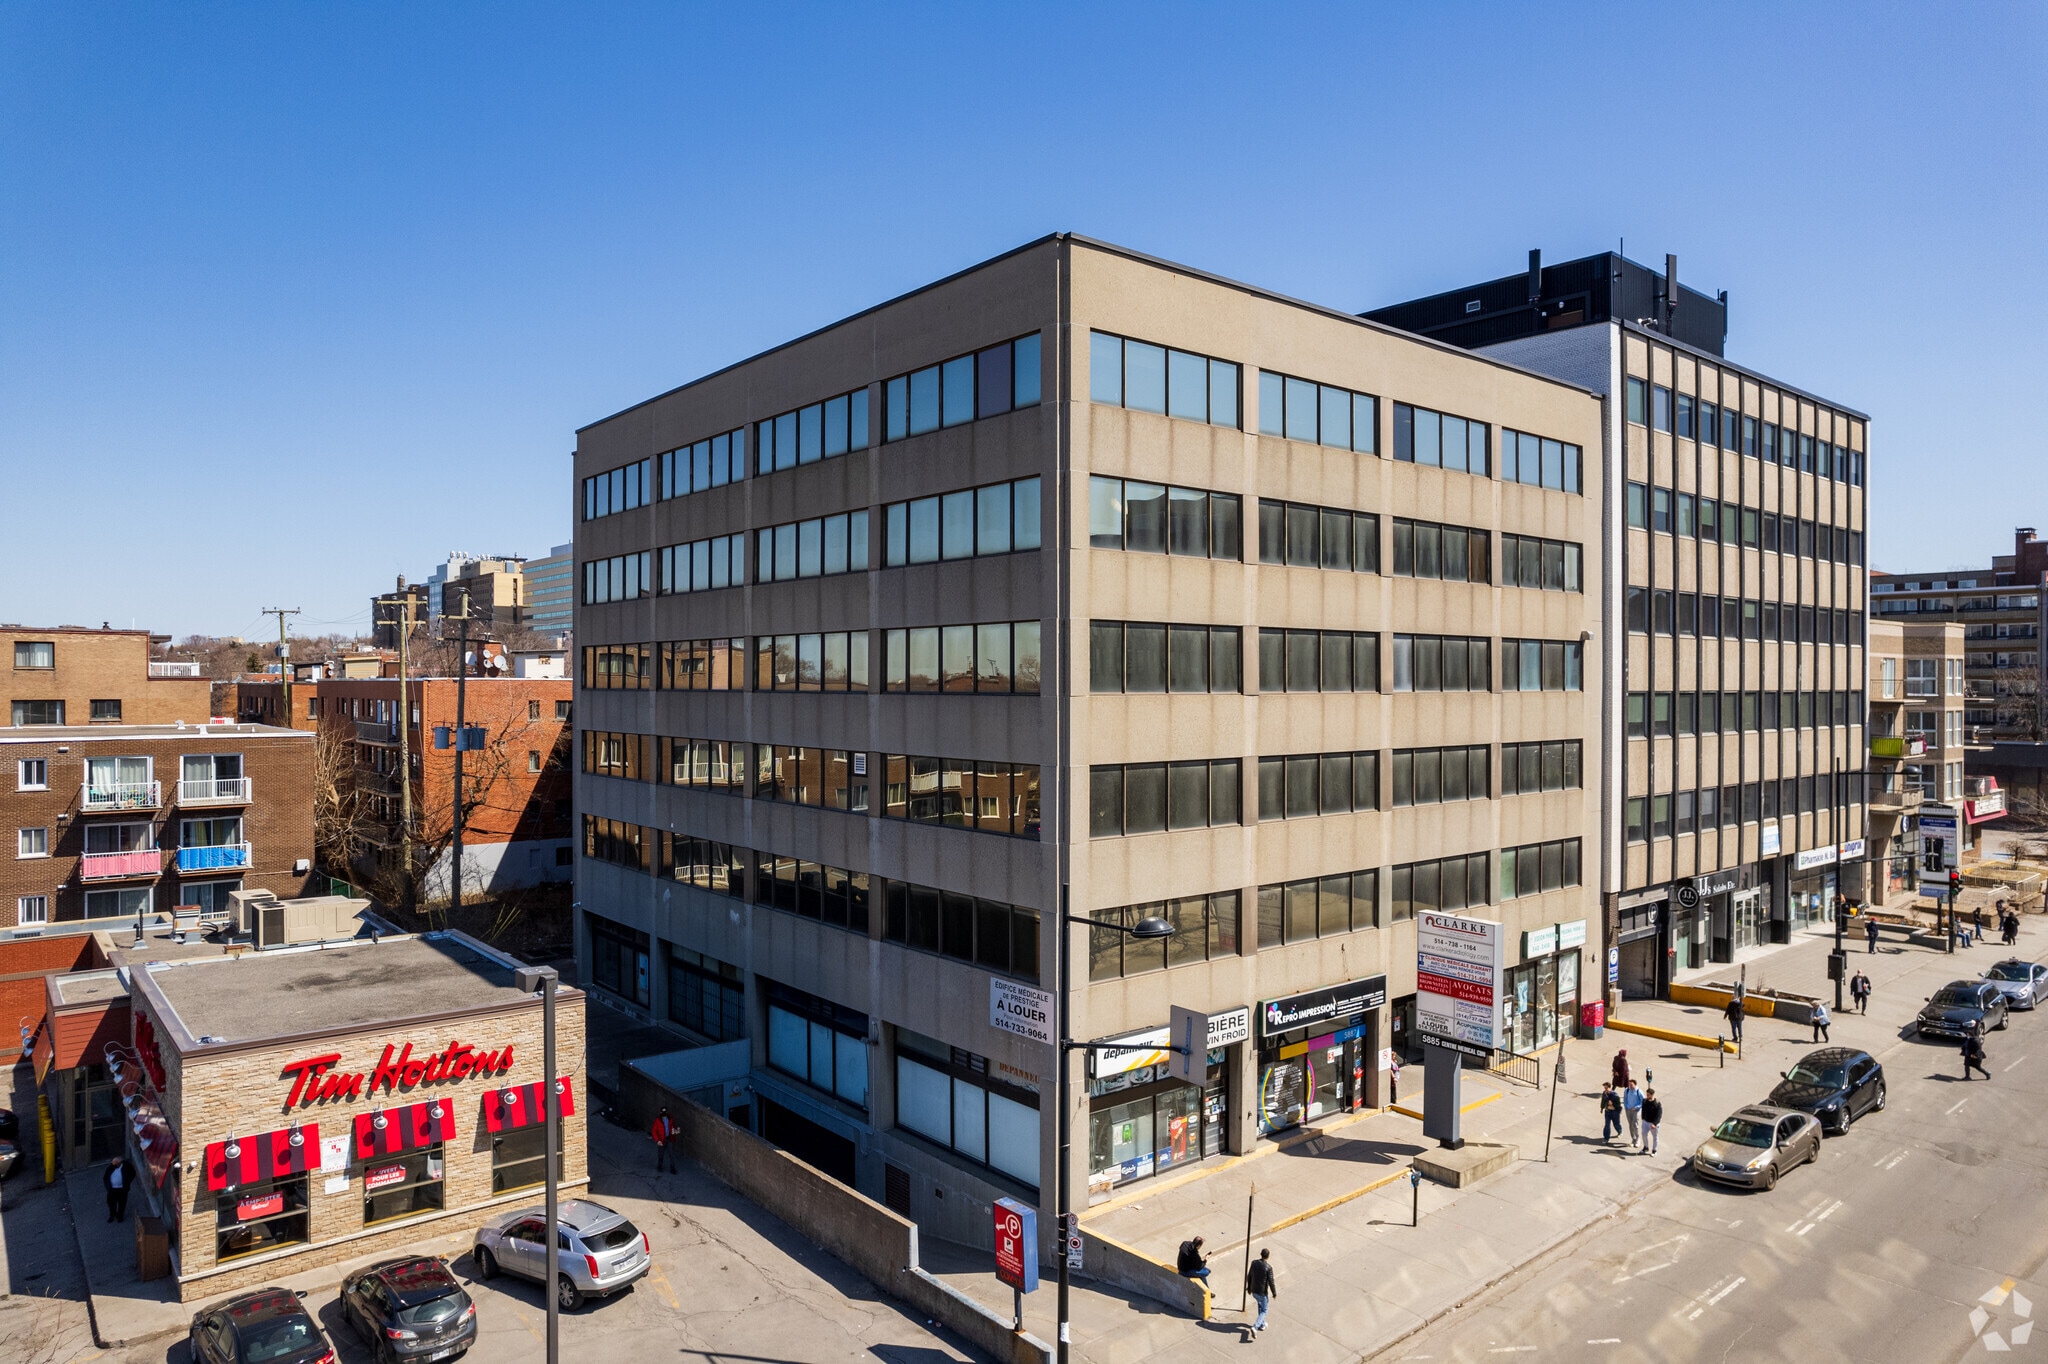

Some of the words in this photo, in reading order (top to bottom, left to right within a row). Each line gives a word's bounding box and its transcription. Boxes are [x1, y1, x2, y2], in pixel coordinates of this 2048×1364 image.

[1805, 854, 1823, 864] Pharmacie
[1436, 918, 1486, 933] CLARKE
[1425, 955, 1446, 964] CLINIQUE
[1470, 964, 1491, 973] DIAMANT
[1419, 973, 1448, 983] BROWNSTEIN
[995, 980, 1016, 993] ÉDIFICE
[1018, 987, 1048, 1002] MÉDICALE
[1452, 982, 1492, 996] AVOCATS
[1011, 994, 1039, 1008] PRESTIGE
[997, 998, 1004, 1010] À
[1008, 1002, 1046, 1023] LOUER
[1299, 1003, 1336, 1019] IMPRESSION
[995, 1018, 1047, 1040] 514-733-9064
[1208, 1015, 1245, 1034] BIÈRE
[1427, 1021, 1448, 1031] LOUER
[1456, 1021, 1491, 1033] ACUPUNCTURE
[1221, 1029, 1246, 1042] FROID
[1423, 1035, 1440, 1046] 5885
[284, 1053, 365, 1107] Tim
[371, 1040, 513, 1091] Hortons
[366, 1176, 405, 1188] COMMANDES
[372, 1174, 388, 1182] POUR
[246, 1194, 280, 1206] EMPORTER
